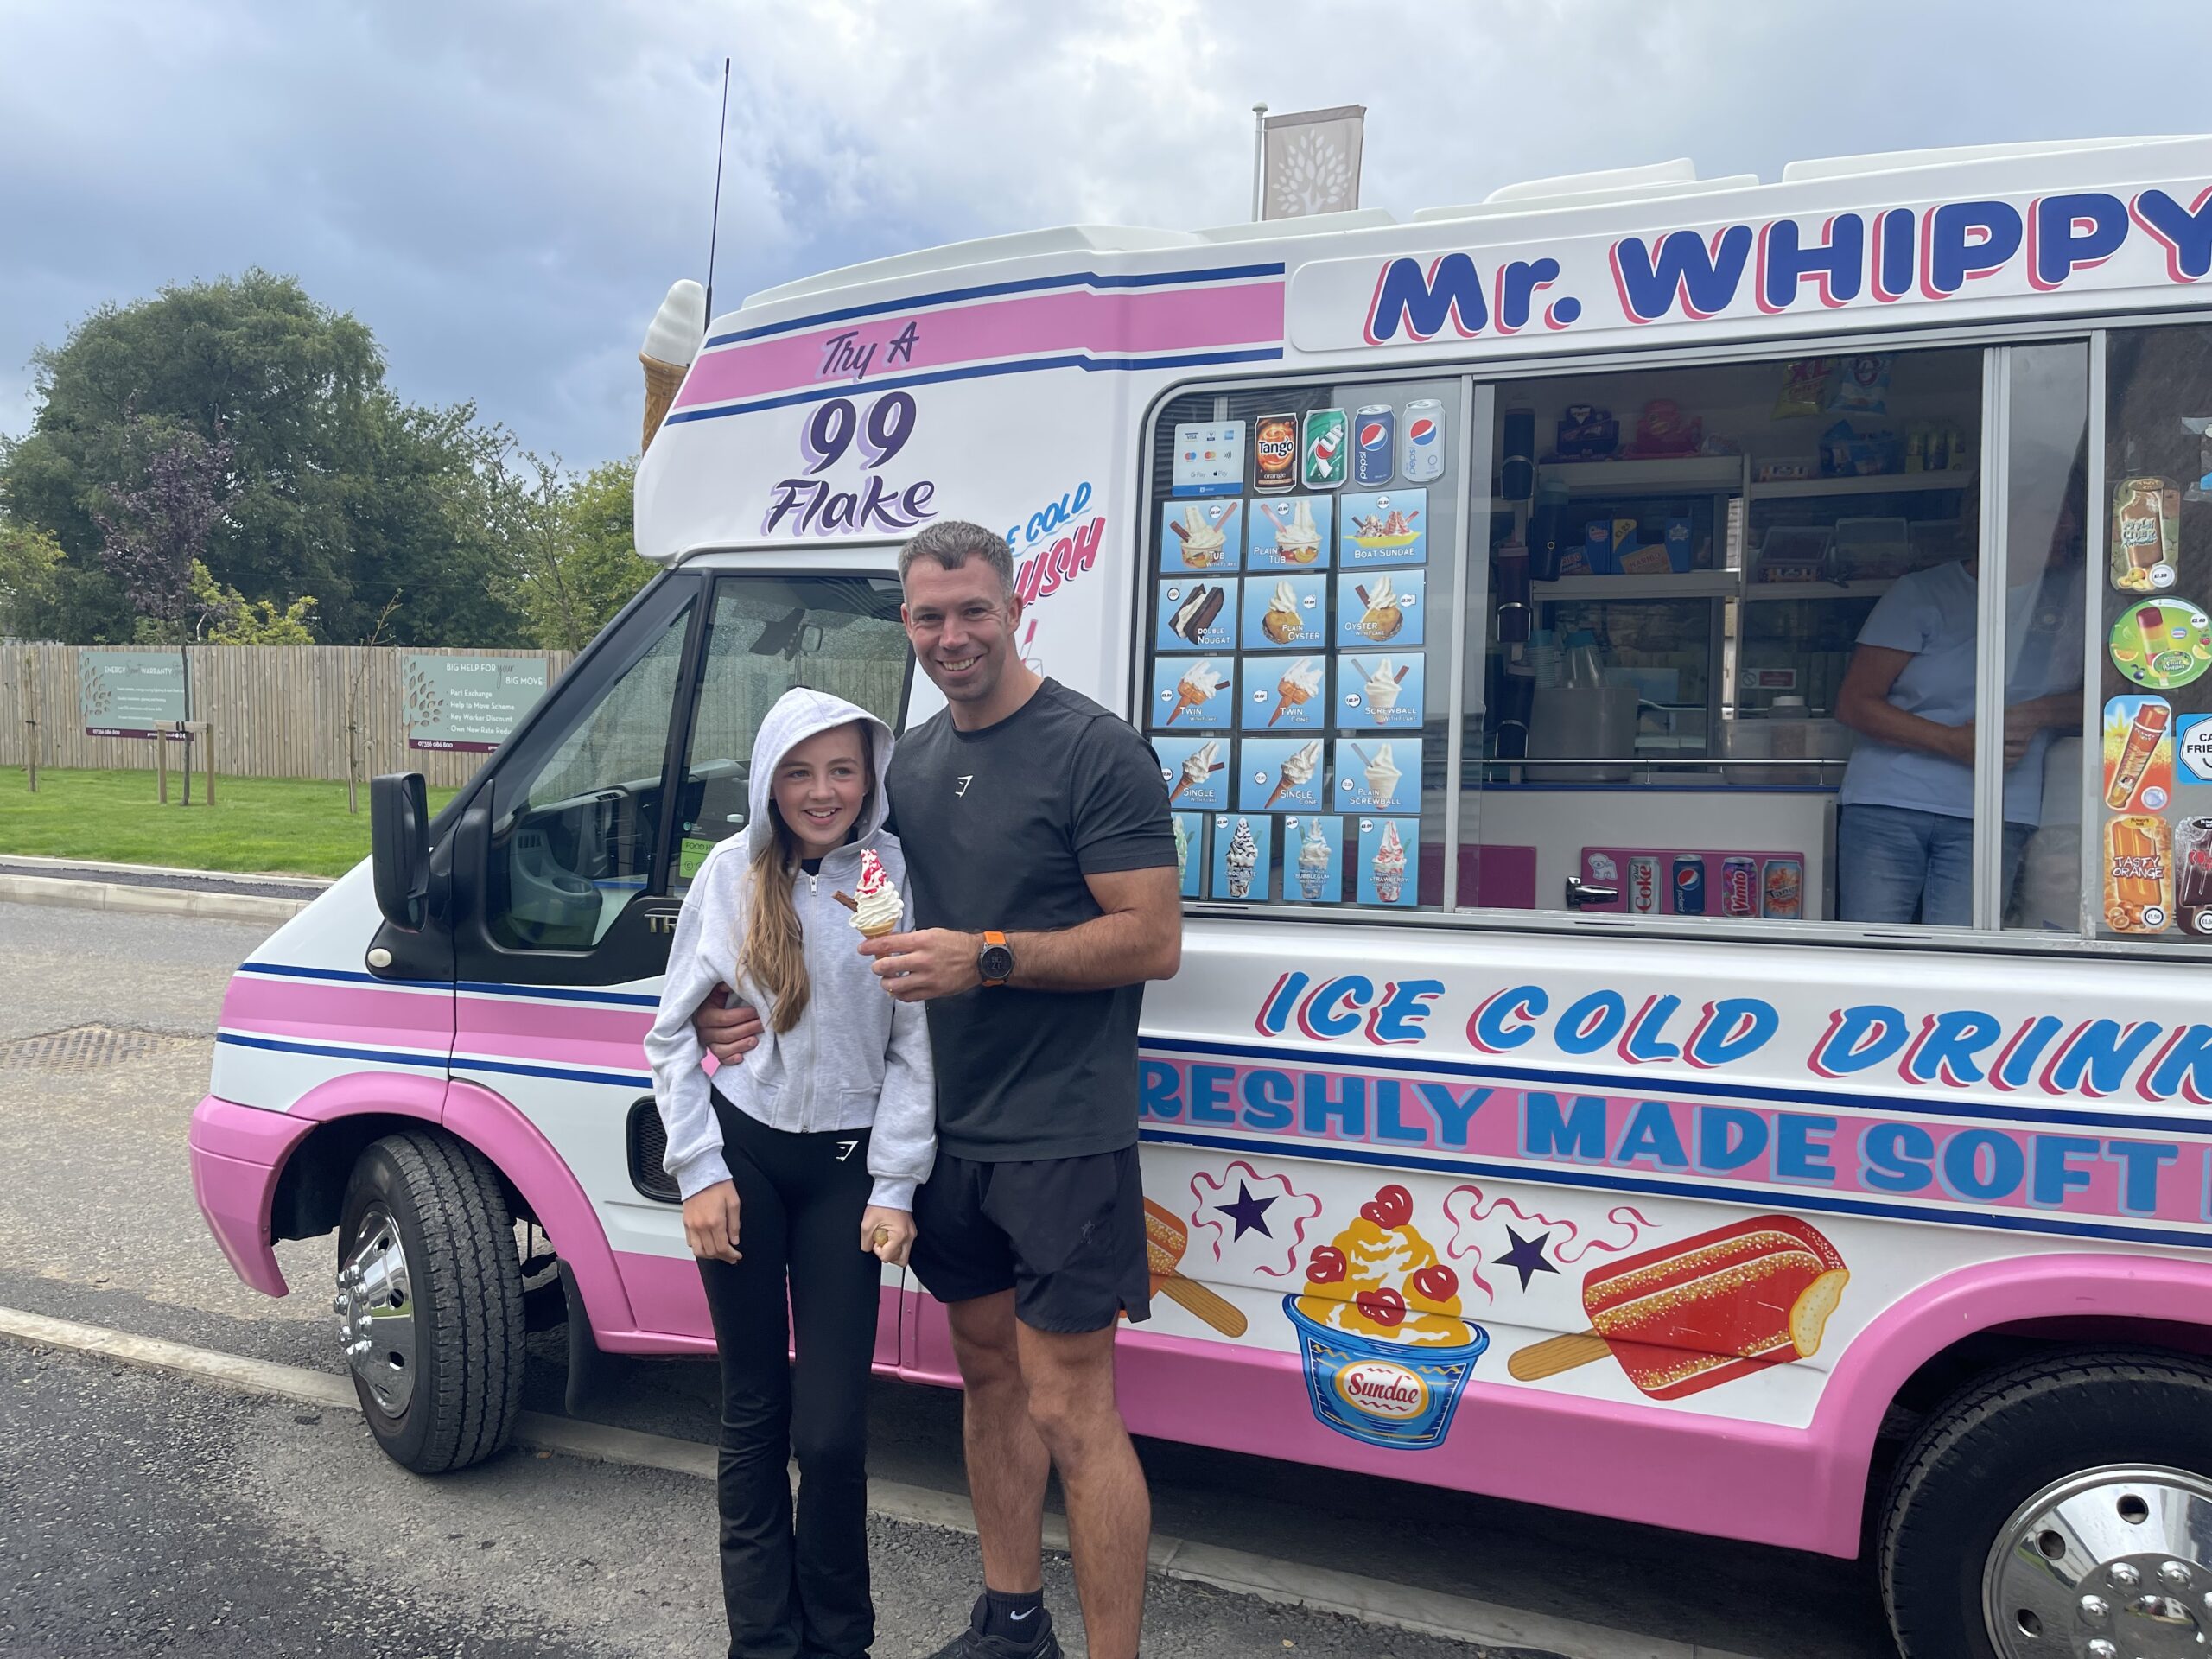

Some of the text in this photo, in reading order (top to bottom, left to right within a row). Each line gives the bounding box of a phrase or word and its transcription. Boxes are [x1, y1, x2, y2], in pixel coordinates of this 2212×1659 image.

[1363, 185, 2212, 346] Mr. WHIPPY
[817, 321, 919, 383] Try A
[801, 391, 917, 476] 99
[1259, 438, 1294, 457] Tango
[1359, 451, 1368, 480] pepsi
[760, 475, 939, 537] Flake
[1026, 481, 1092, 542] COLD
[1209, 550, 1225, 560] TUB
[1254, 546, 1279, 555] PLAIN
[1354, 547, 1415, 559] BOAT SUNDAE
[1014, 517, 1106, 609] USH
[1269, 555, 1286, 564] TUB
[1344, 622, 1378, 631] OYSTER
[1198, 636, 1230, 645] NOUGAT
[1288, 632, 1320, 641] OYSTER
[104, 665, 126, 674] ENERGY
[446, 663, 459, 671] BIG
[496, 664, 514, 690] your
[505, 677, 543, 686] BIG MOVE
[464, 690, 493, 698] Exchange
[491, 702, 515, 711] Scheme
[1179, 707, 1202, 715] TWIN
[1280, 707, 1303, 715] TWIN
[450, 713, 462, 722] Key
[486, 714, 512, 723] Discount
[1183, 787, 1214, 798] SINGLE
[1280, 789, 1312, 799] SINGLE
[1350, 797, 1402, 805] SCREWBALL
[685, 842, 705, 850] FOOD
[2114, 856, 2159, 868] TASTY
[2113, 867, 2164, 879] ORANGE
[1635, 864, 1651, 912] Coke
[1731, 870, 1750, 912] Vimto
[1676, 889, 1685, 912] pepsi
[1255, 971, 1445, 1045] ICE
[1466, 985, 1778, 1069] COLD
[1139, 1059, 1495, 1150] RESHLY
[1517, 1090, 1836, 1187] MADE
[1857, 1122, 2179, 1218] SOFT
[1348, 1372, 1419, 1405] Sundae
